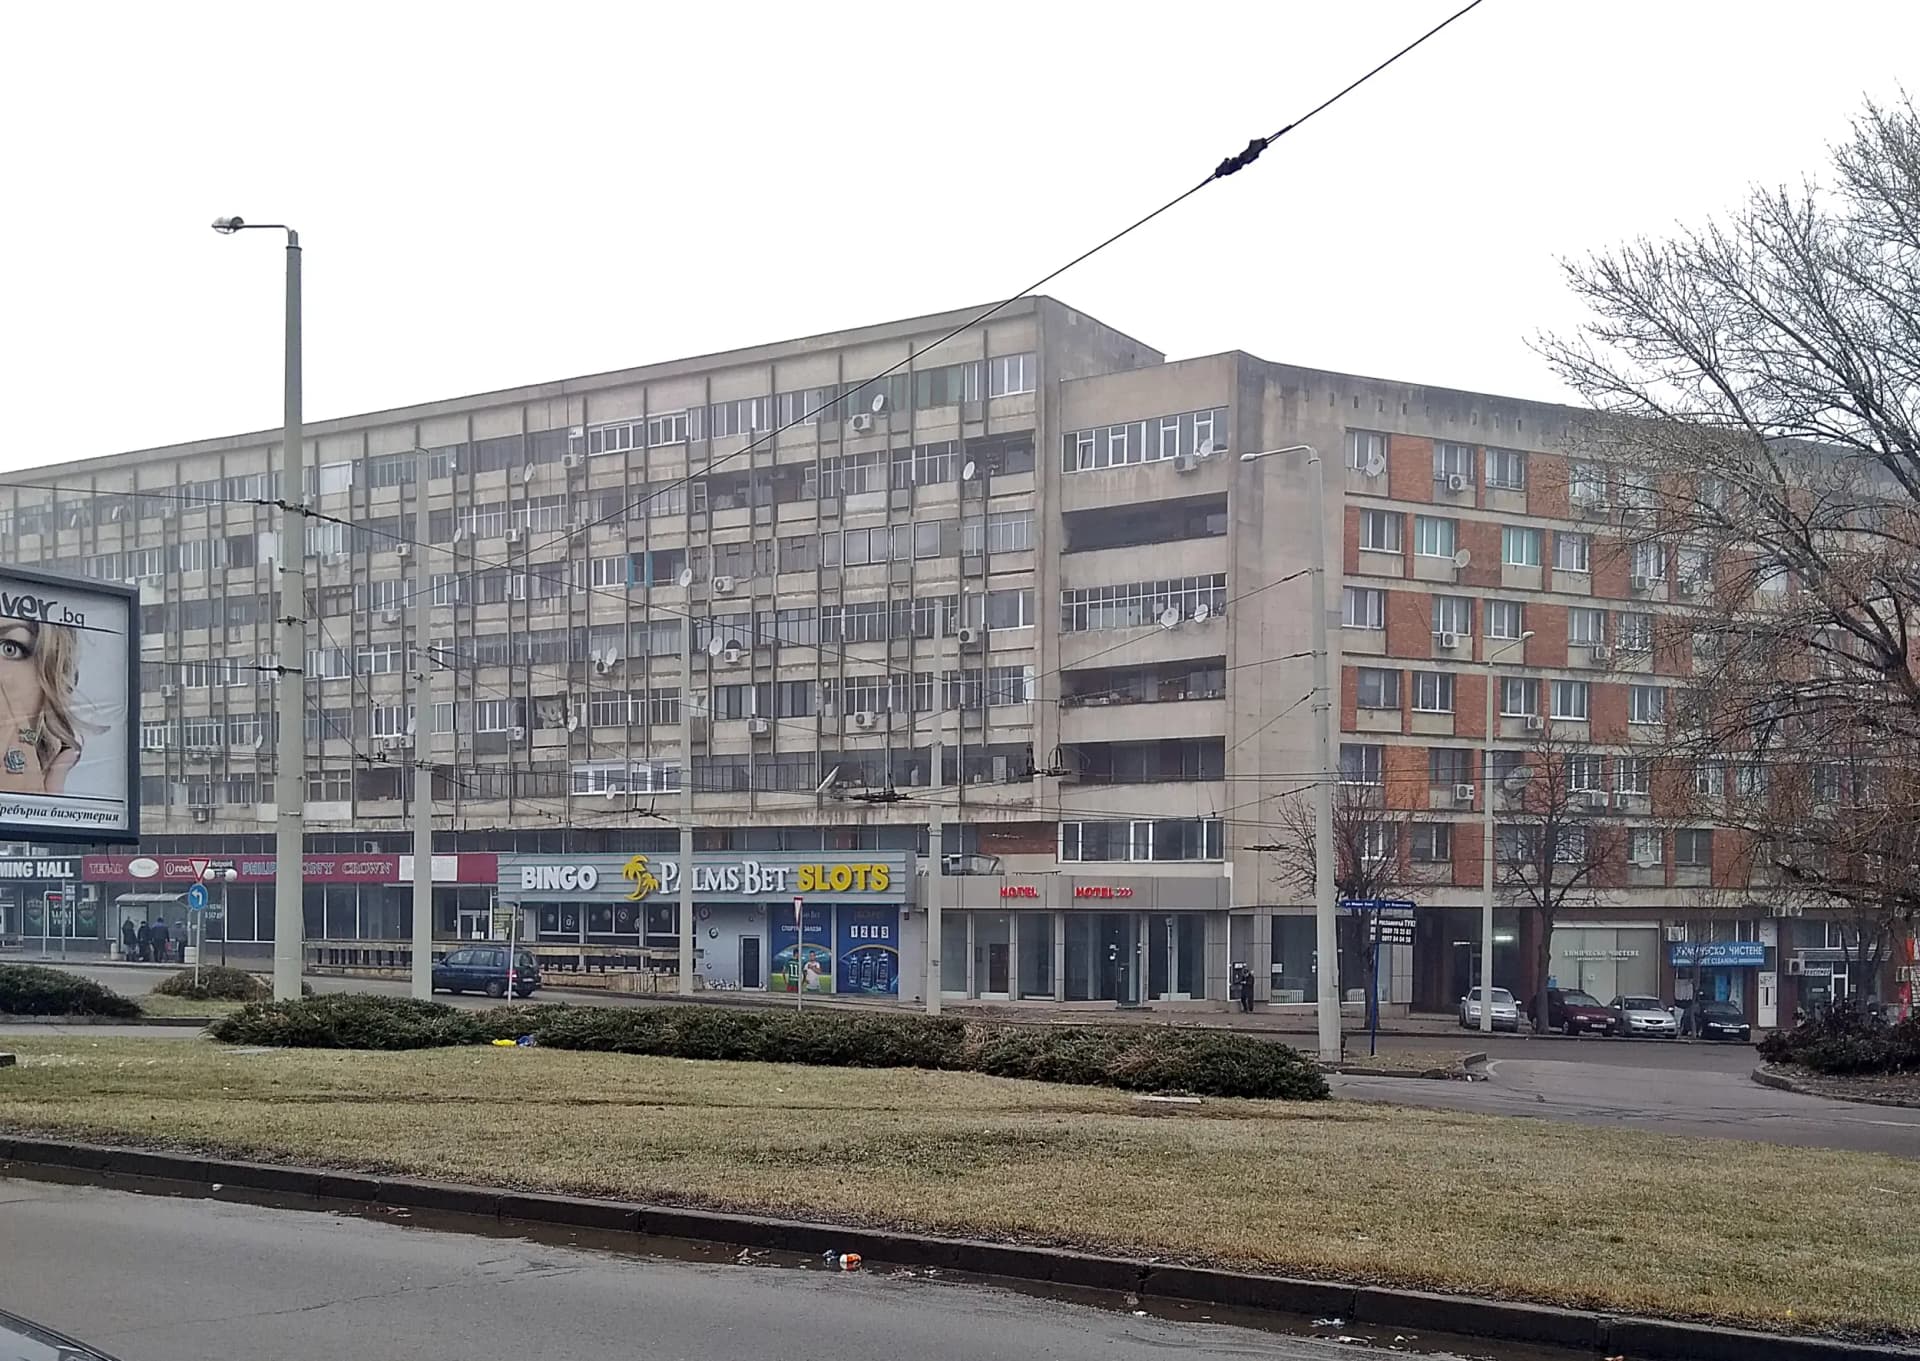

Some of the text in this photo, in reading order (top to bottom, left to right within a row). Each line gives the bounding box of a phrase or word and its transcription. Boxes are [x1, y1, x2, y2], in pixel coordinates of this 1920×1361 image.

[50, 808, 119, 823] бижутерия
[36, 862, 74, 877] HALL
[242, 861, 277, 875] PHILIP
[341, 861, 393, 875] CROWN
[521, 866, 599, 891] BINGO
[798, 864, 889, 892] SLOTS
[999, 886, 1039, 897] HOTEL
[1074, 886, 1114, 898] HOTEL
[1729, 945, 1763, 956] ЧИСТЕНЕ
